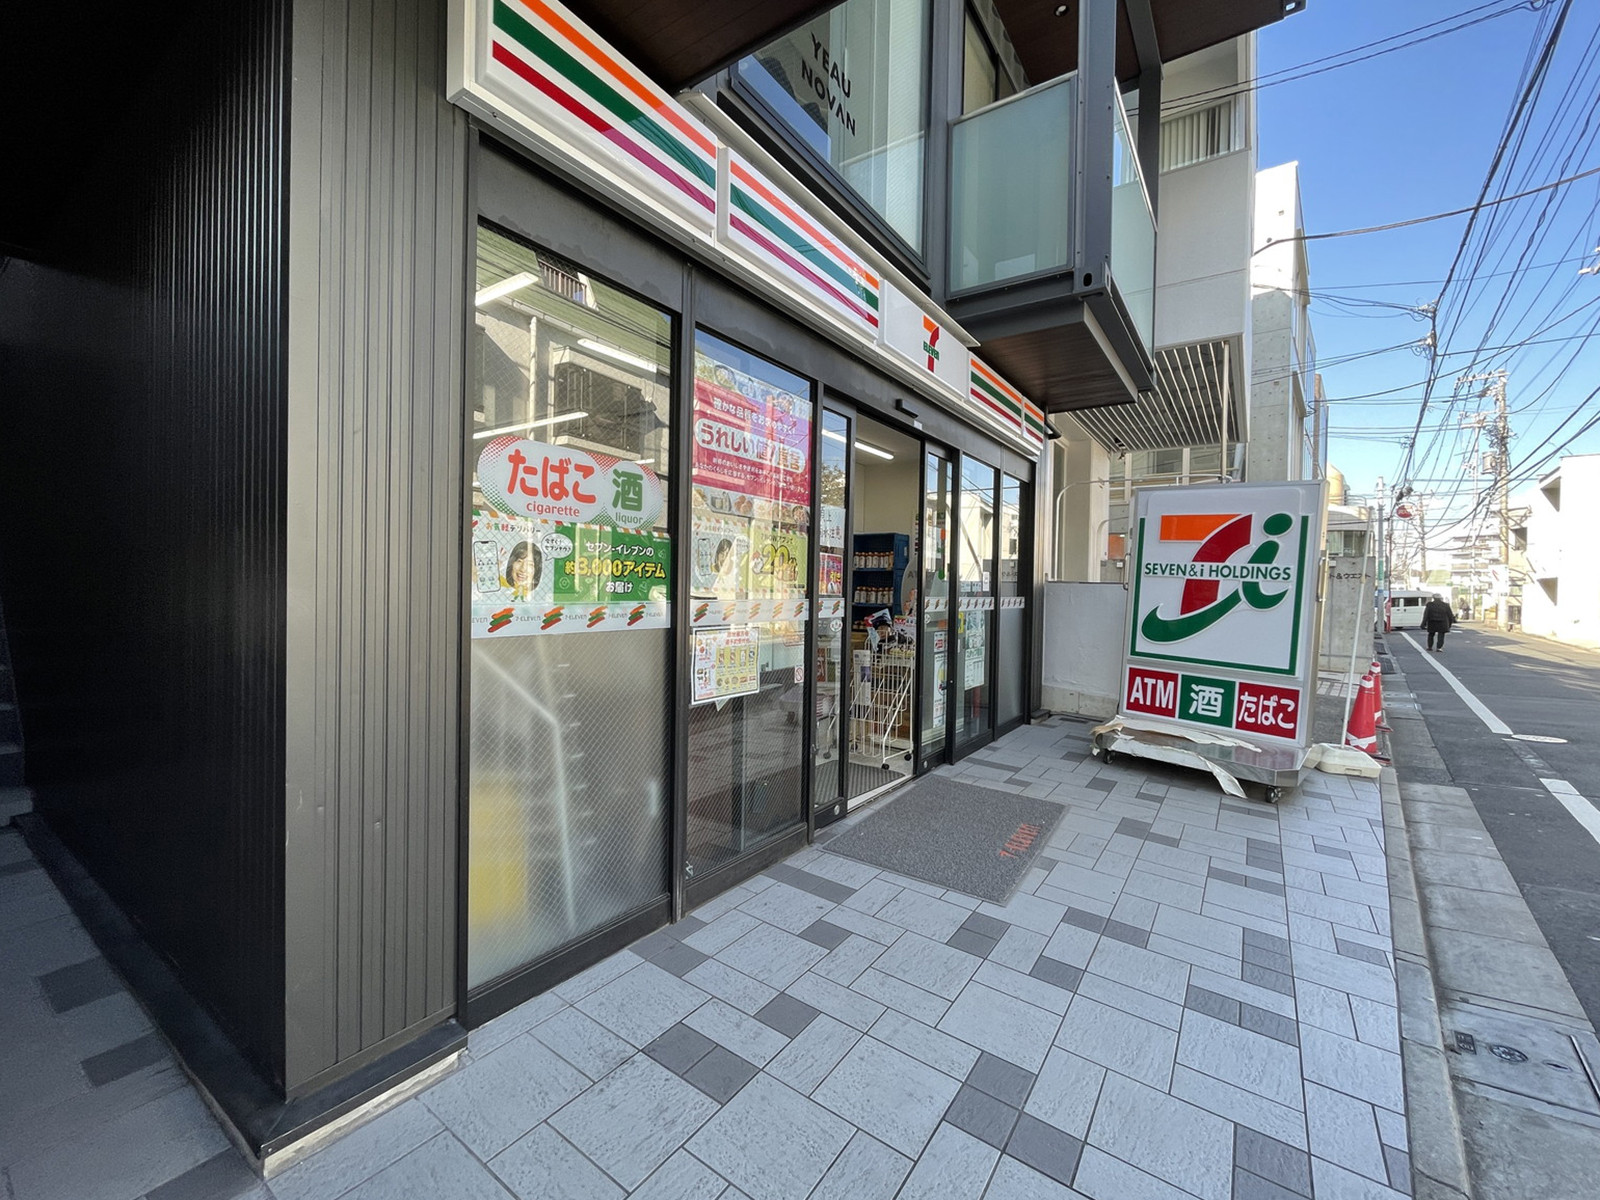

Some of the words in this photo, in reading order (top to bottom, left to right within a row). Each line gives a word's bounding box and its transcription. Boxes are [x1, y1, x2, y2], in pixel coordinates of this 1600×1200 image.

[811, 32, 851, 98] YEAU
[507, 449, 597, 504] たばこ
[612, 468, 643, 512] 酒
[526, 500, 580, 518] cigarette
[615, 511, 644, 525] liquor
[1209, 564, 1291, 581] HOLDINGS
[605, 581, 633, 593] お届け
[1129, 676, 1175, 710] ATM
[1189, 683, 1224, 718] 酒
[1238, 691, 1295, 730] たばこ
